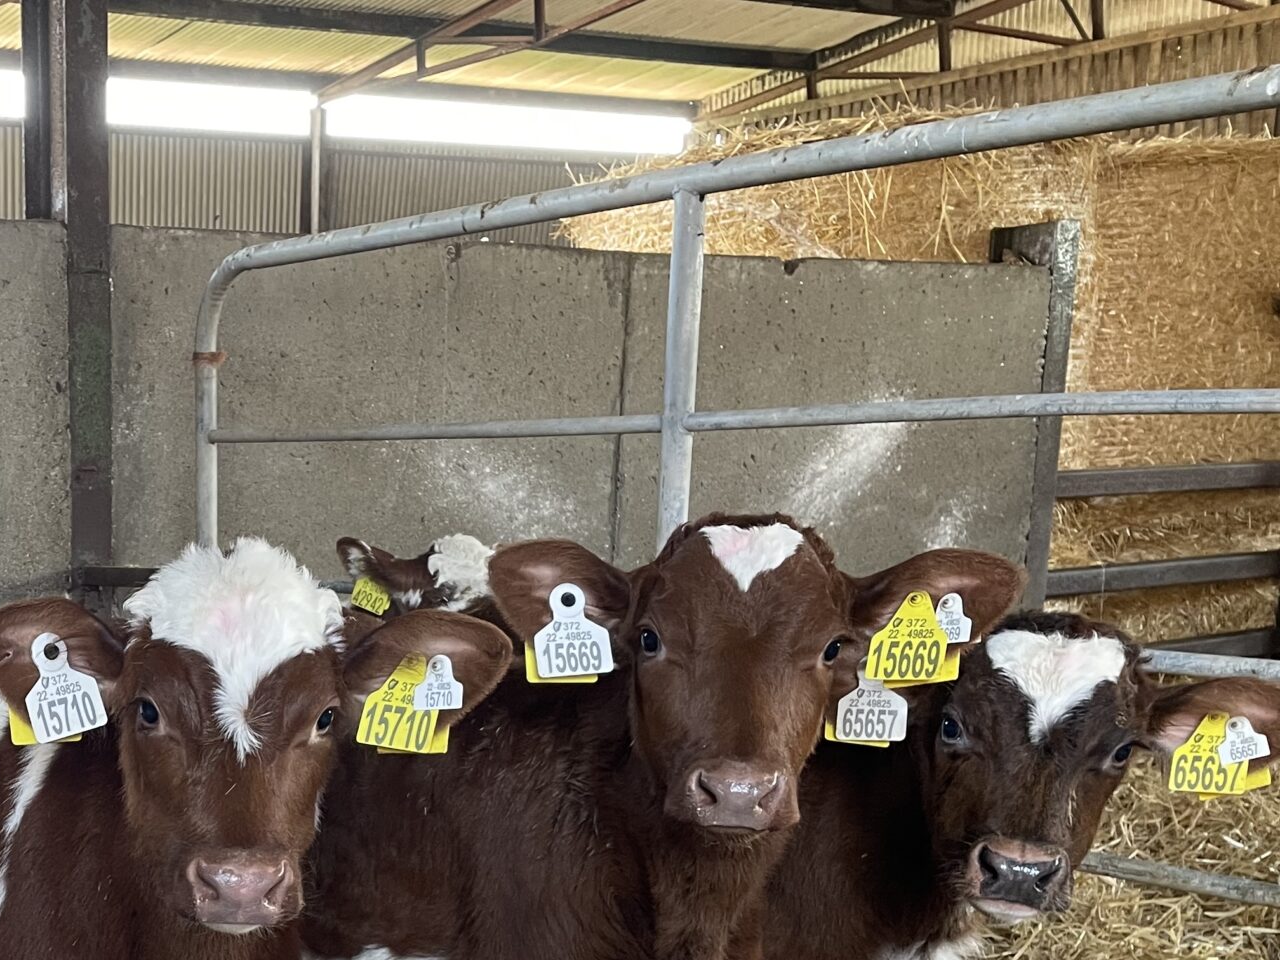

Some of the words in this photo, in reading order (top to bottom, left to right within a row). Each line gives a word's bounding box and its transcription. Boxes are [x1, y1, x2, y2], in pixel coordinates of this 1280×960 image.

[563, 621, 580, 631] 372
[906, 618, 927, 628] 372
[543, 640, 602, 674] 15669
[872, 640, 940, 679] 15669
[51, 673, 68, 686] 372
[400, 682, 415, 692] 37
[425, 691, 453, 708] 15710
[866, 690, 882, 698] 372
[37, 691, 97, 738] 15710
[842, 708, 898, 739] 65657
[365, 702, 432, 751] 15710
[1230, 743, 1258, 761] 65657
[1174, 754, 1244, 792] 65657
